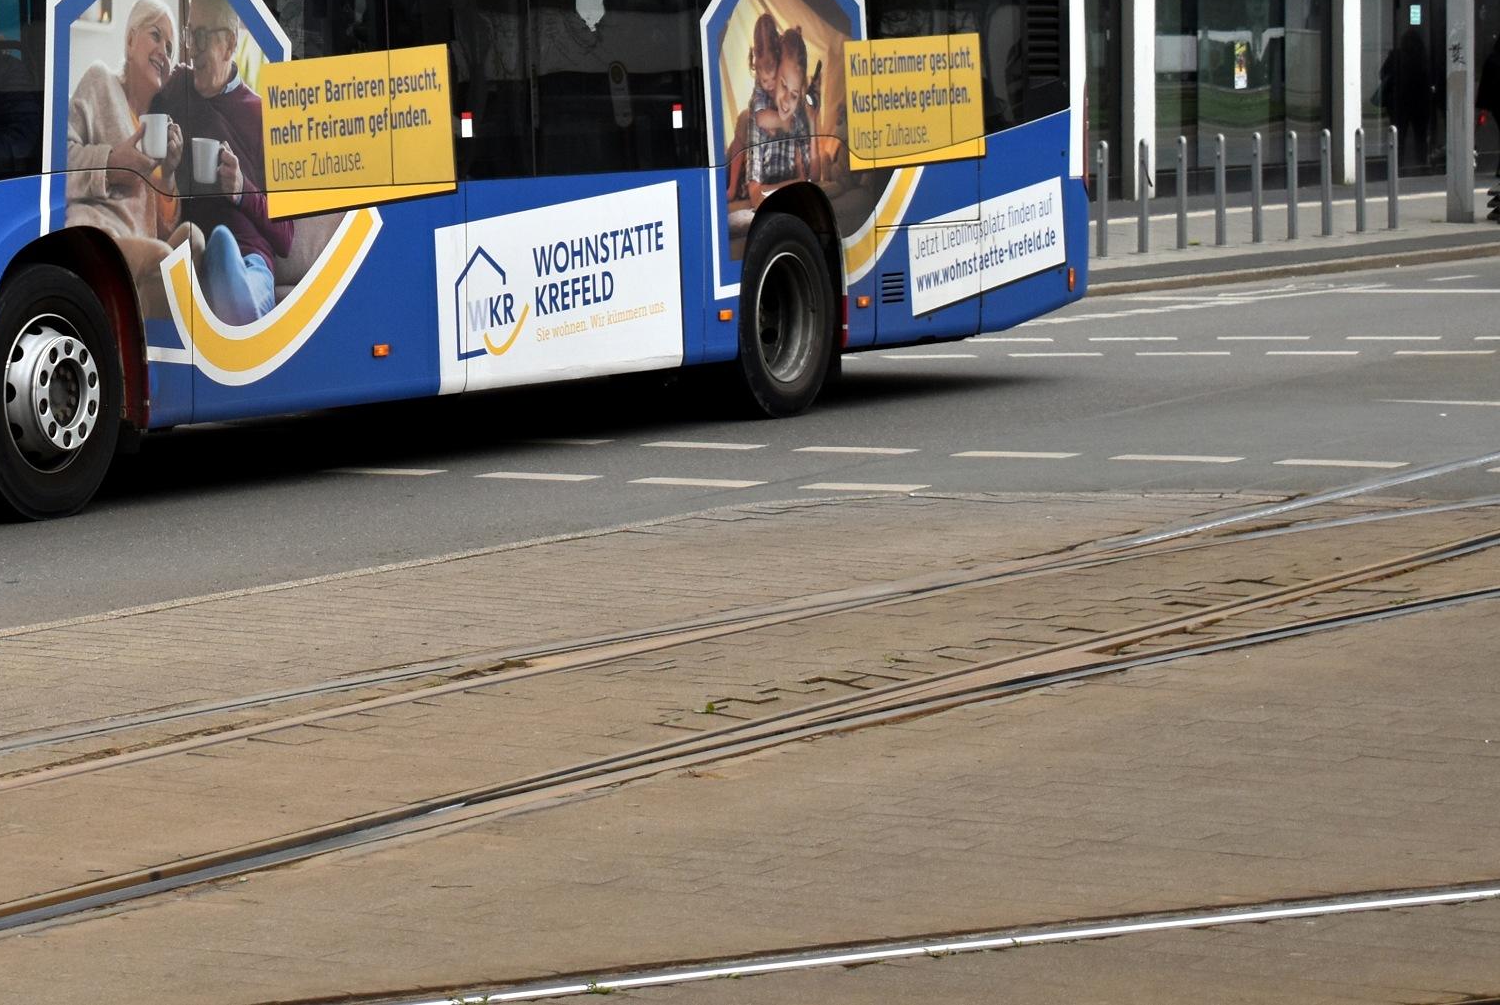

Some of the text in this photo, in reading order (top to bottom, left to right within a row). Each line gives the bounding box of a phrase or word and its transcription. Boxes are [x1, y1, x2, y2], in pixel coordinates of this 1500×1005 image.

[929, 46, 974, 76] gesucht,
[267, 67, 442, 111] Weniger Barrieren gesucht,
[851, 83, 971, 113] Kuschelecke gefunden.
[270, 105, 432, 146] mehr Freiraum gefunden.
[853, 123, 930, 150] Unser Zuhause.
[272, 151, 365, 182] Unser Zuhause.
[915, 192, 1053, 260] Jetzt Lieblingsplatz finden auf
[532, 220, 664, 277] WOHNSTÄTTE
[916, 227, 1056, 292] www.wohnstaette-krefeld.de
[468, 292, 516, 332] WKR
[535, 270, 614, 317] KREFELD
[536, 301, 666, 342] Sie wohnen. Wir kümmern uns.
